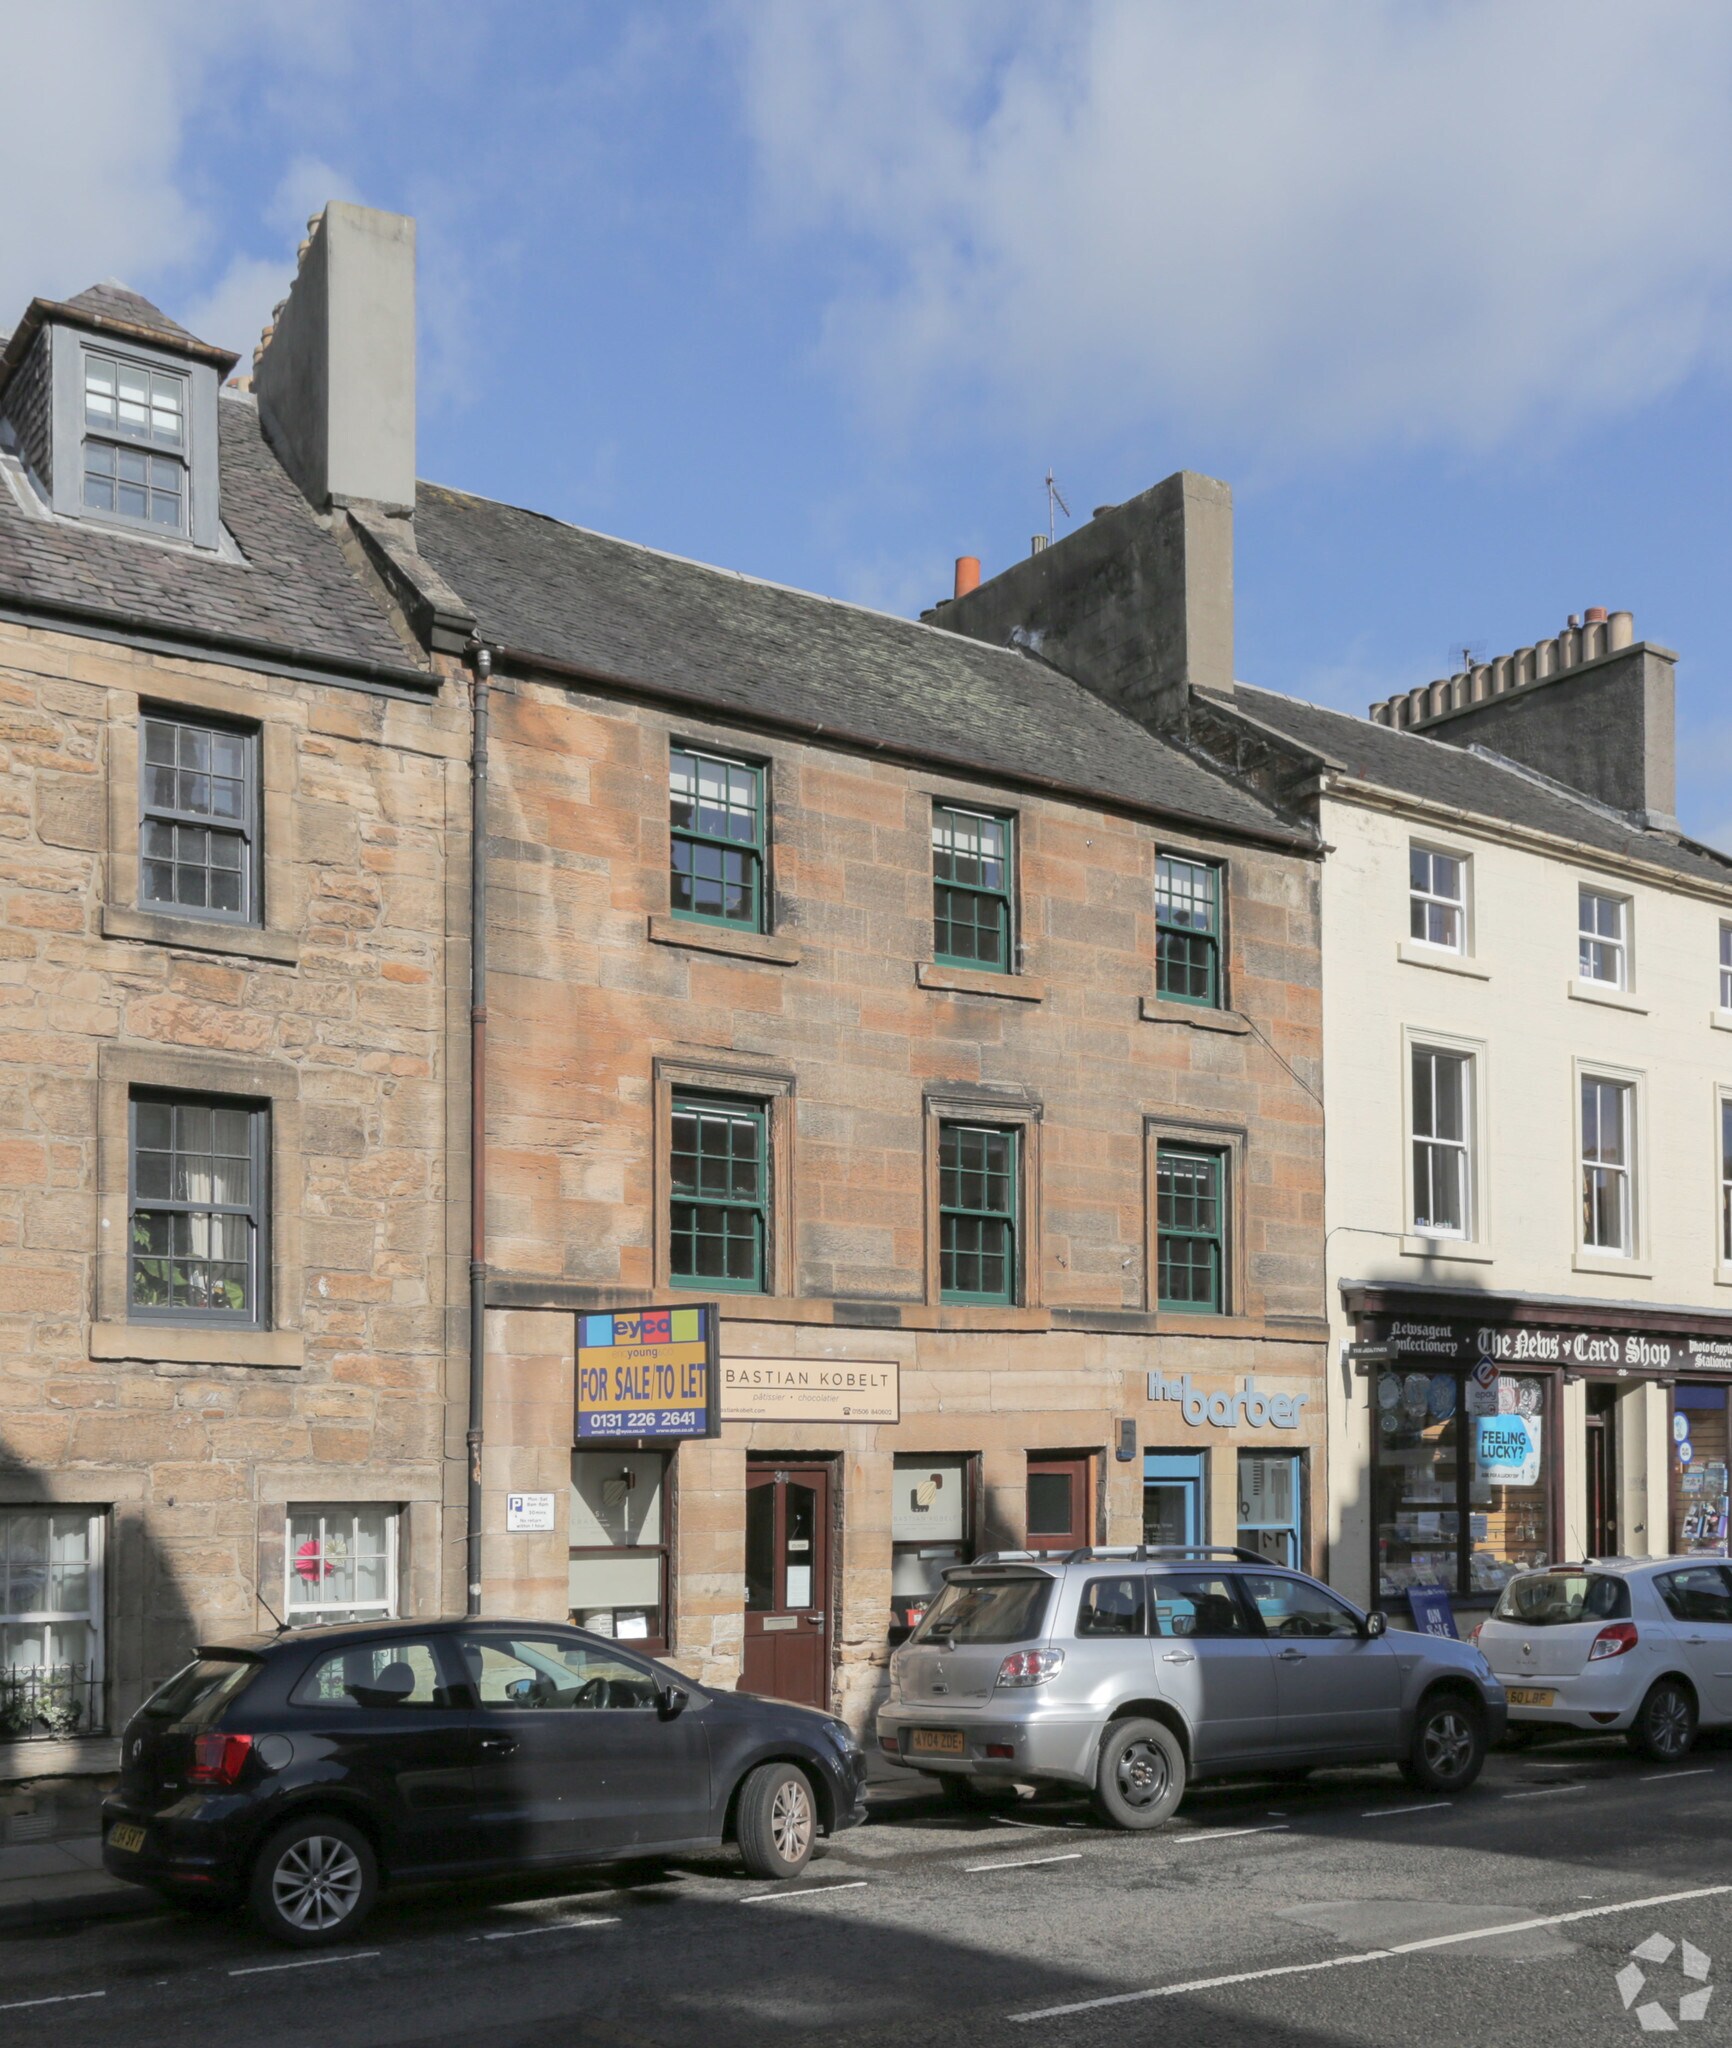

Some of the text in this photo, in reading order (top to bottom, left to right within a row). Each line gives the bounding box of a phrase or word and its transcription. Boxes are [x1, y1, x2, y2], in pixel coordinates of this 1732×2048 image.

[613, 1318, 671, 1338] eyco
[1390, 1321, 1453, 1339] Newsagent
[1477, 1327, 1671, 1367] The News Card Shop
[581, 1367, 608, 1402] FOR
[681, 1363, 706, 1398] LET
[719, 1368, 888, 1387] BASTIAN KOBELT
[752, 1392, 840, 1403] pâtissier chocolatier
[1147, 1372, 1309, 1428] the barber
[1475, 1391, 1496, 1401] epay
[591, 1411, 695, 1427] 0131 226 2641
[1481, 1430, 1526, 1445] FEELING
[1481, 1445, 1524, 1459] LUCKY?
[774, 1471, 789, 1484] 34
[1426, 1609, 1442, 1623] ON
[914, 1731, 939, 1748] AY04
